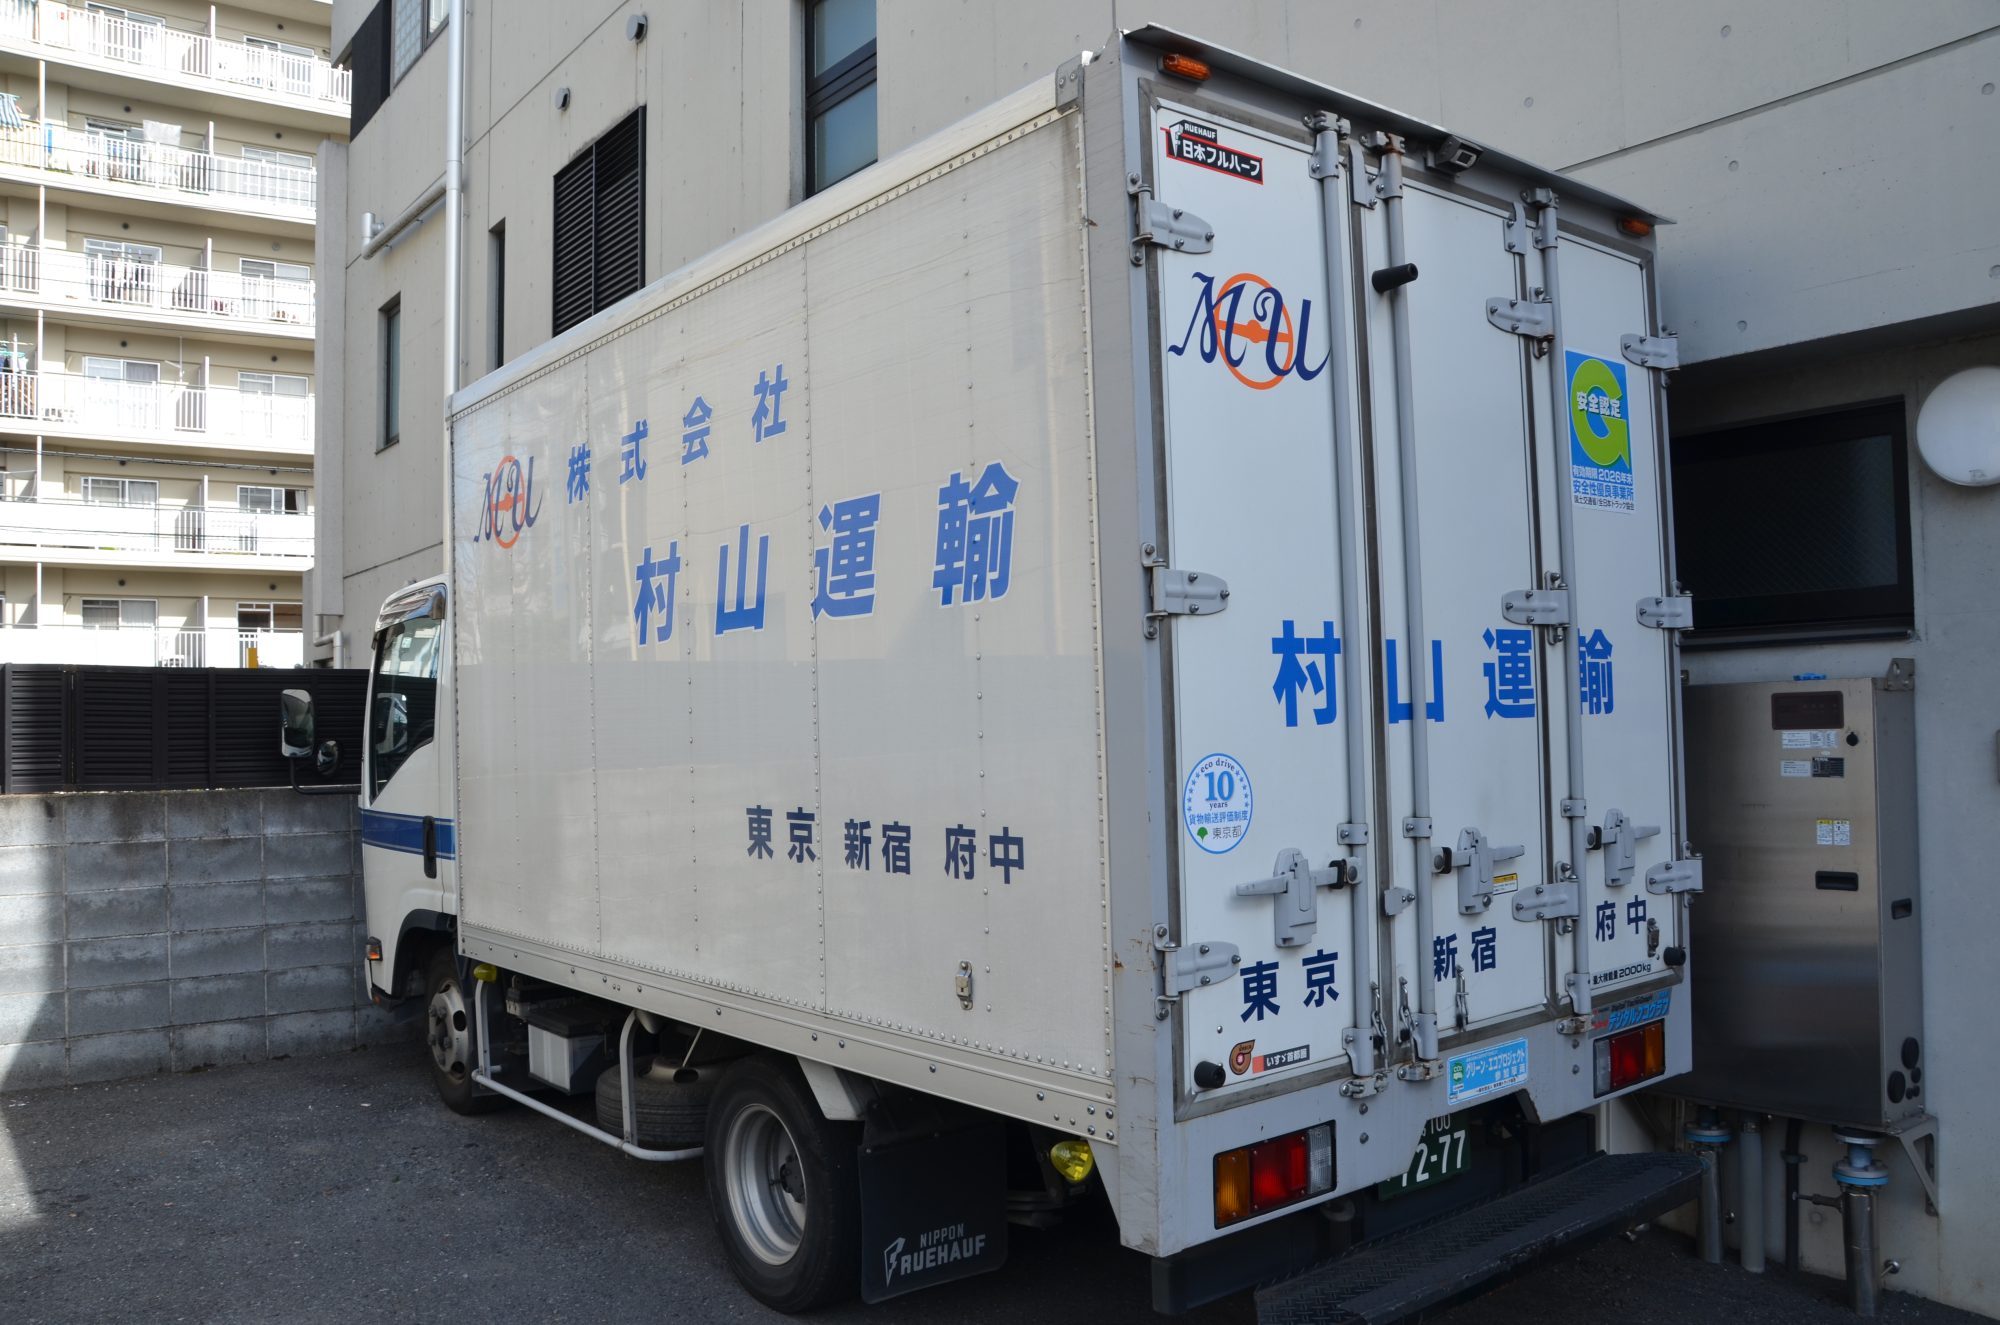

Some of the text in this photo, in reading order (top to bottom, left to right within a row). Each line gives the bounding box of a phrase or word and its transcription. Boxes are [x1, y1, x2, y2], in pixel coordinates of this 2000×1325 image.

[1183, 140, 1260, 176] 日本フルハーフ
[1576, 391, 1621, 418] 安全認定
[566, 362, 790, 504] 株式会社
[633, 459, 1021, 647] 村山運輸
[1200, 757, 1236, 774] eco drive
[1204, 770, 1235, 801] 10
[1188, 810, 1249, 826] 貨物輸送評価制度
[1209, 801, 1229, 811] years
[746, 804, 1025, 885] 東京 新宿 府中
[1212, 825, 1242, 839] 東京都
[1239, 895, 1648, 1023] 東京 新宿 府中
[920, 1223, 964, 1249] NIPPON
